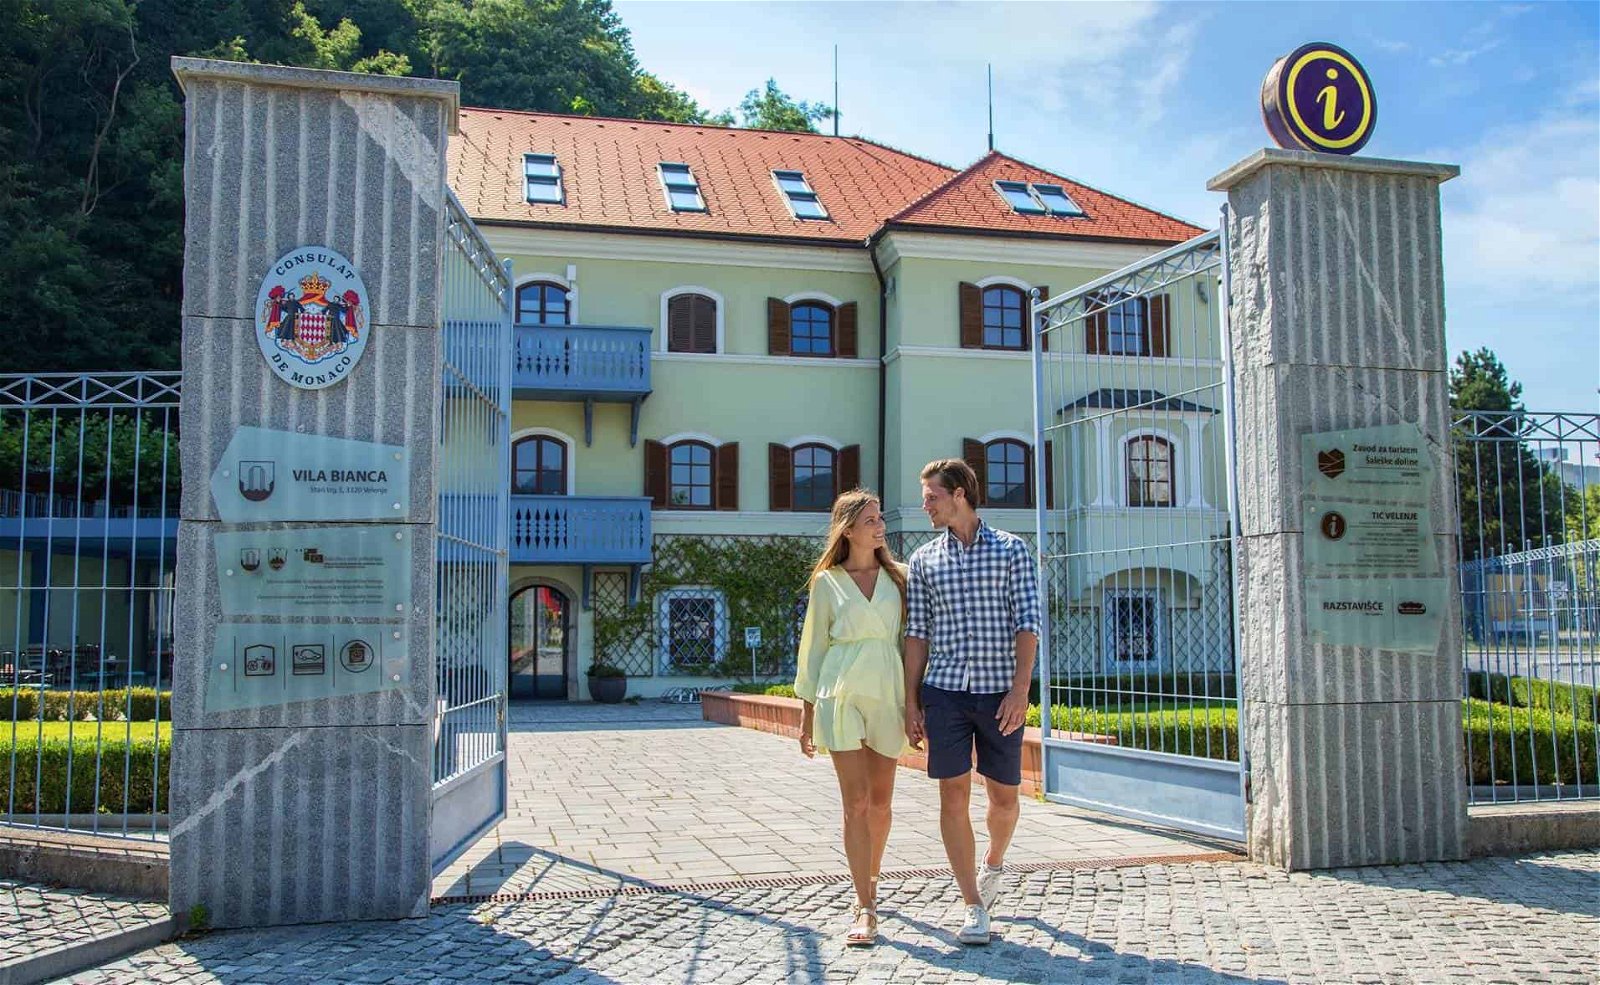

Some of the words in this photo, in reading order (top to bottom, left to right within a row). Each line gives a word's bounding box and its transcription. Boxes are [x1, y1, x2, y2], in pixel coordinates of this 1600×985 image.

[1316, 68, 1345, 130] i
[276, 253, 355, 280] CONSULAT
[272, 352, 288, 372] DE
[291, 355, 351, 385] MONACO
[1353, 444, 1376, 453] Zavod
[1388, 445, 1418, 454] turizem
[1394, 457, 1418, 466] doline
[292, 470, 327, 482] VILA
[331, 470, 387, 482] BIANCA
[1372, 511, 1384, 520] TIC
[1385, 511, 1418, 521] VELENJE
[1323, 600, 1384, 611] RAZSTAVIŠČE
